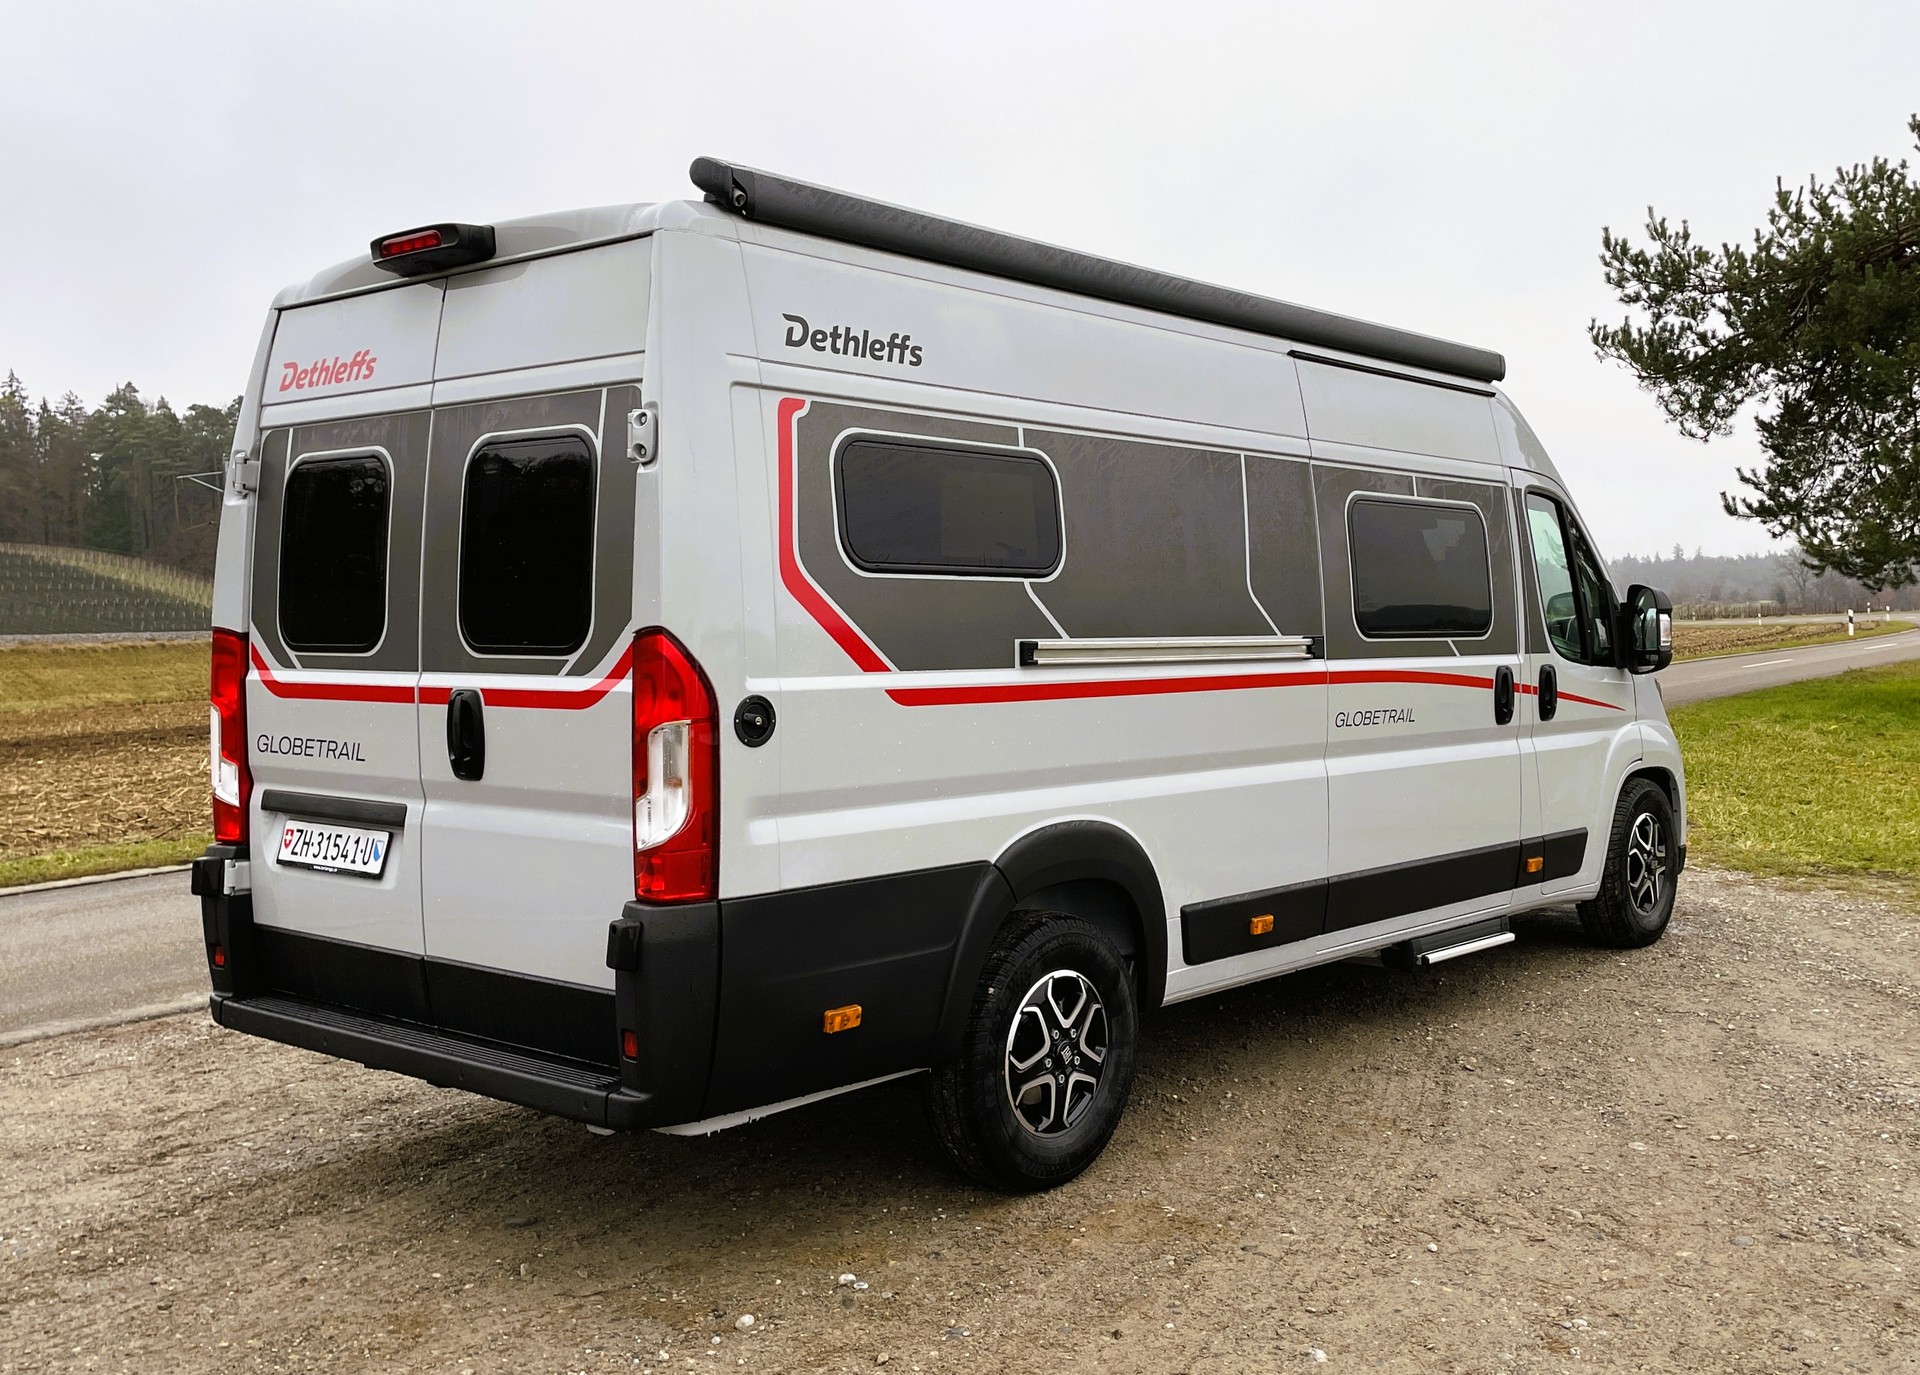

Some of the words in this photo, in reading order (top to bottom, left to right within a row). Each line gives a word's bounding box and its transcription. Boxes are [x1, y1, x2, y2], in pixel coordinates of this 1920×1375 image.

[782, 313, 923, 367] Dethleffs
[279, 349, 377, 392] Dethleffs
[1335, 708, 1416, 728] GLOBETRAIL
[257, 734, 366, 762] GLOBETRAIL
